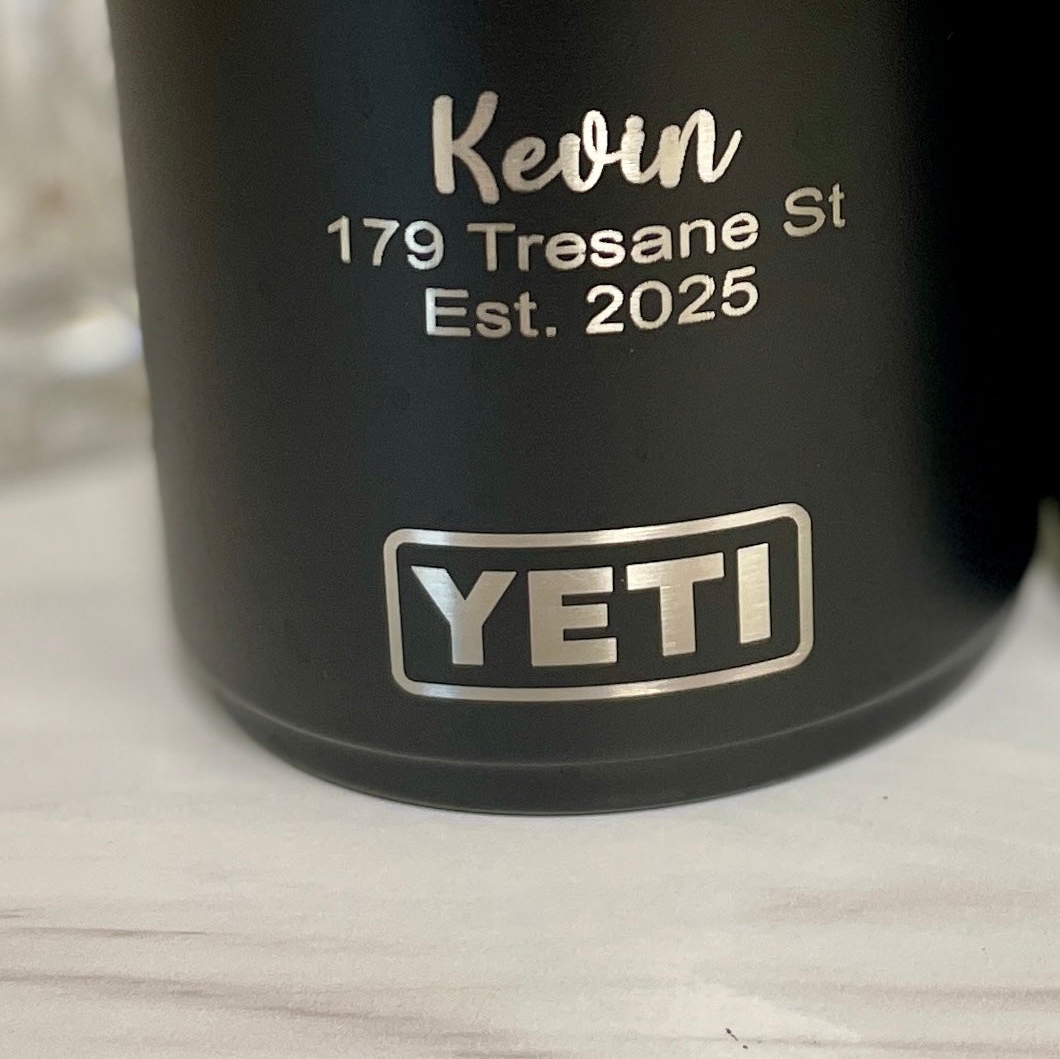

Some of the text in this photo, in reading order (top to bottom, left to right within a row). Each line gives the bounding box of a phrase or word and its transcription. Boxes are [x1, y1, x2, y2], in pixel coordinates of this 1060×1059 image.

[431, 90, 743, 204] Kevin
[326, 182, 847, 272] 179 Tresane St
[423, 264, 760, 338] Est. 2025
[409, 541, 773, 668] YETI
